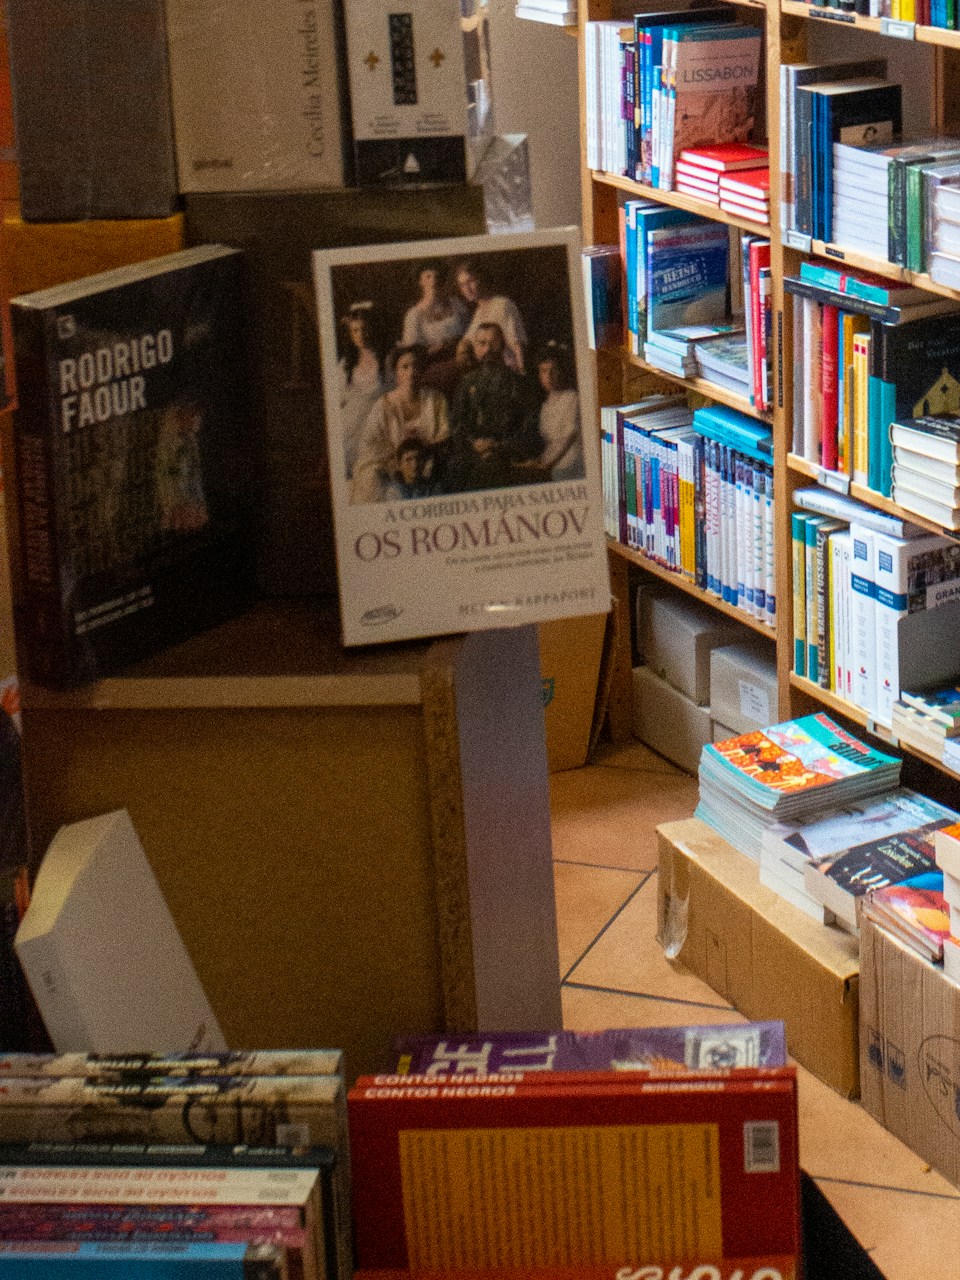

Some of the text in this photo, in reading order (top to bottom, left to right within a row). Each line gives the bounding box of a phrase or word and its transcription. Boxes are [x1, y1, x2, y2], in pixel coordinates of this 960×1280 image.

[299, 9, 322, 90] Meireles
[683, 65, 754, 83] LISSABON
[61, 329, 174, 395] RODRIGO
[61, 375, 148, 433] FAOUR
[386, 486, 589, 524] A CORRIDA PARA SALVAR
[354, 505, 591, 562] OS ROMÁNOV
[364, 1085, 517, 1100] CONTOS NEGROS
[374, 1071, 525, 1087] CONTOS NEGROS
